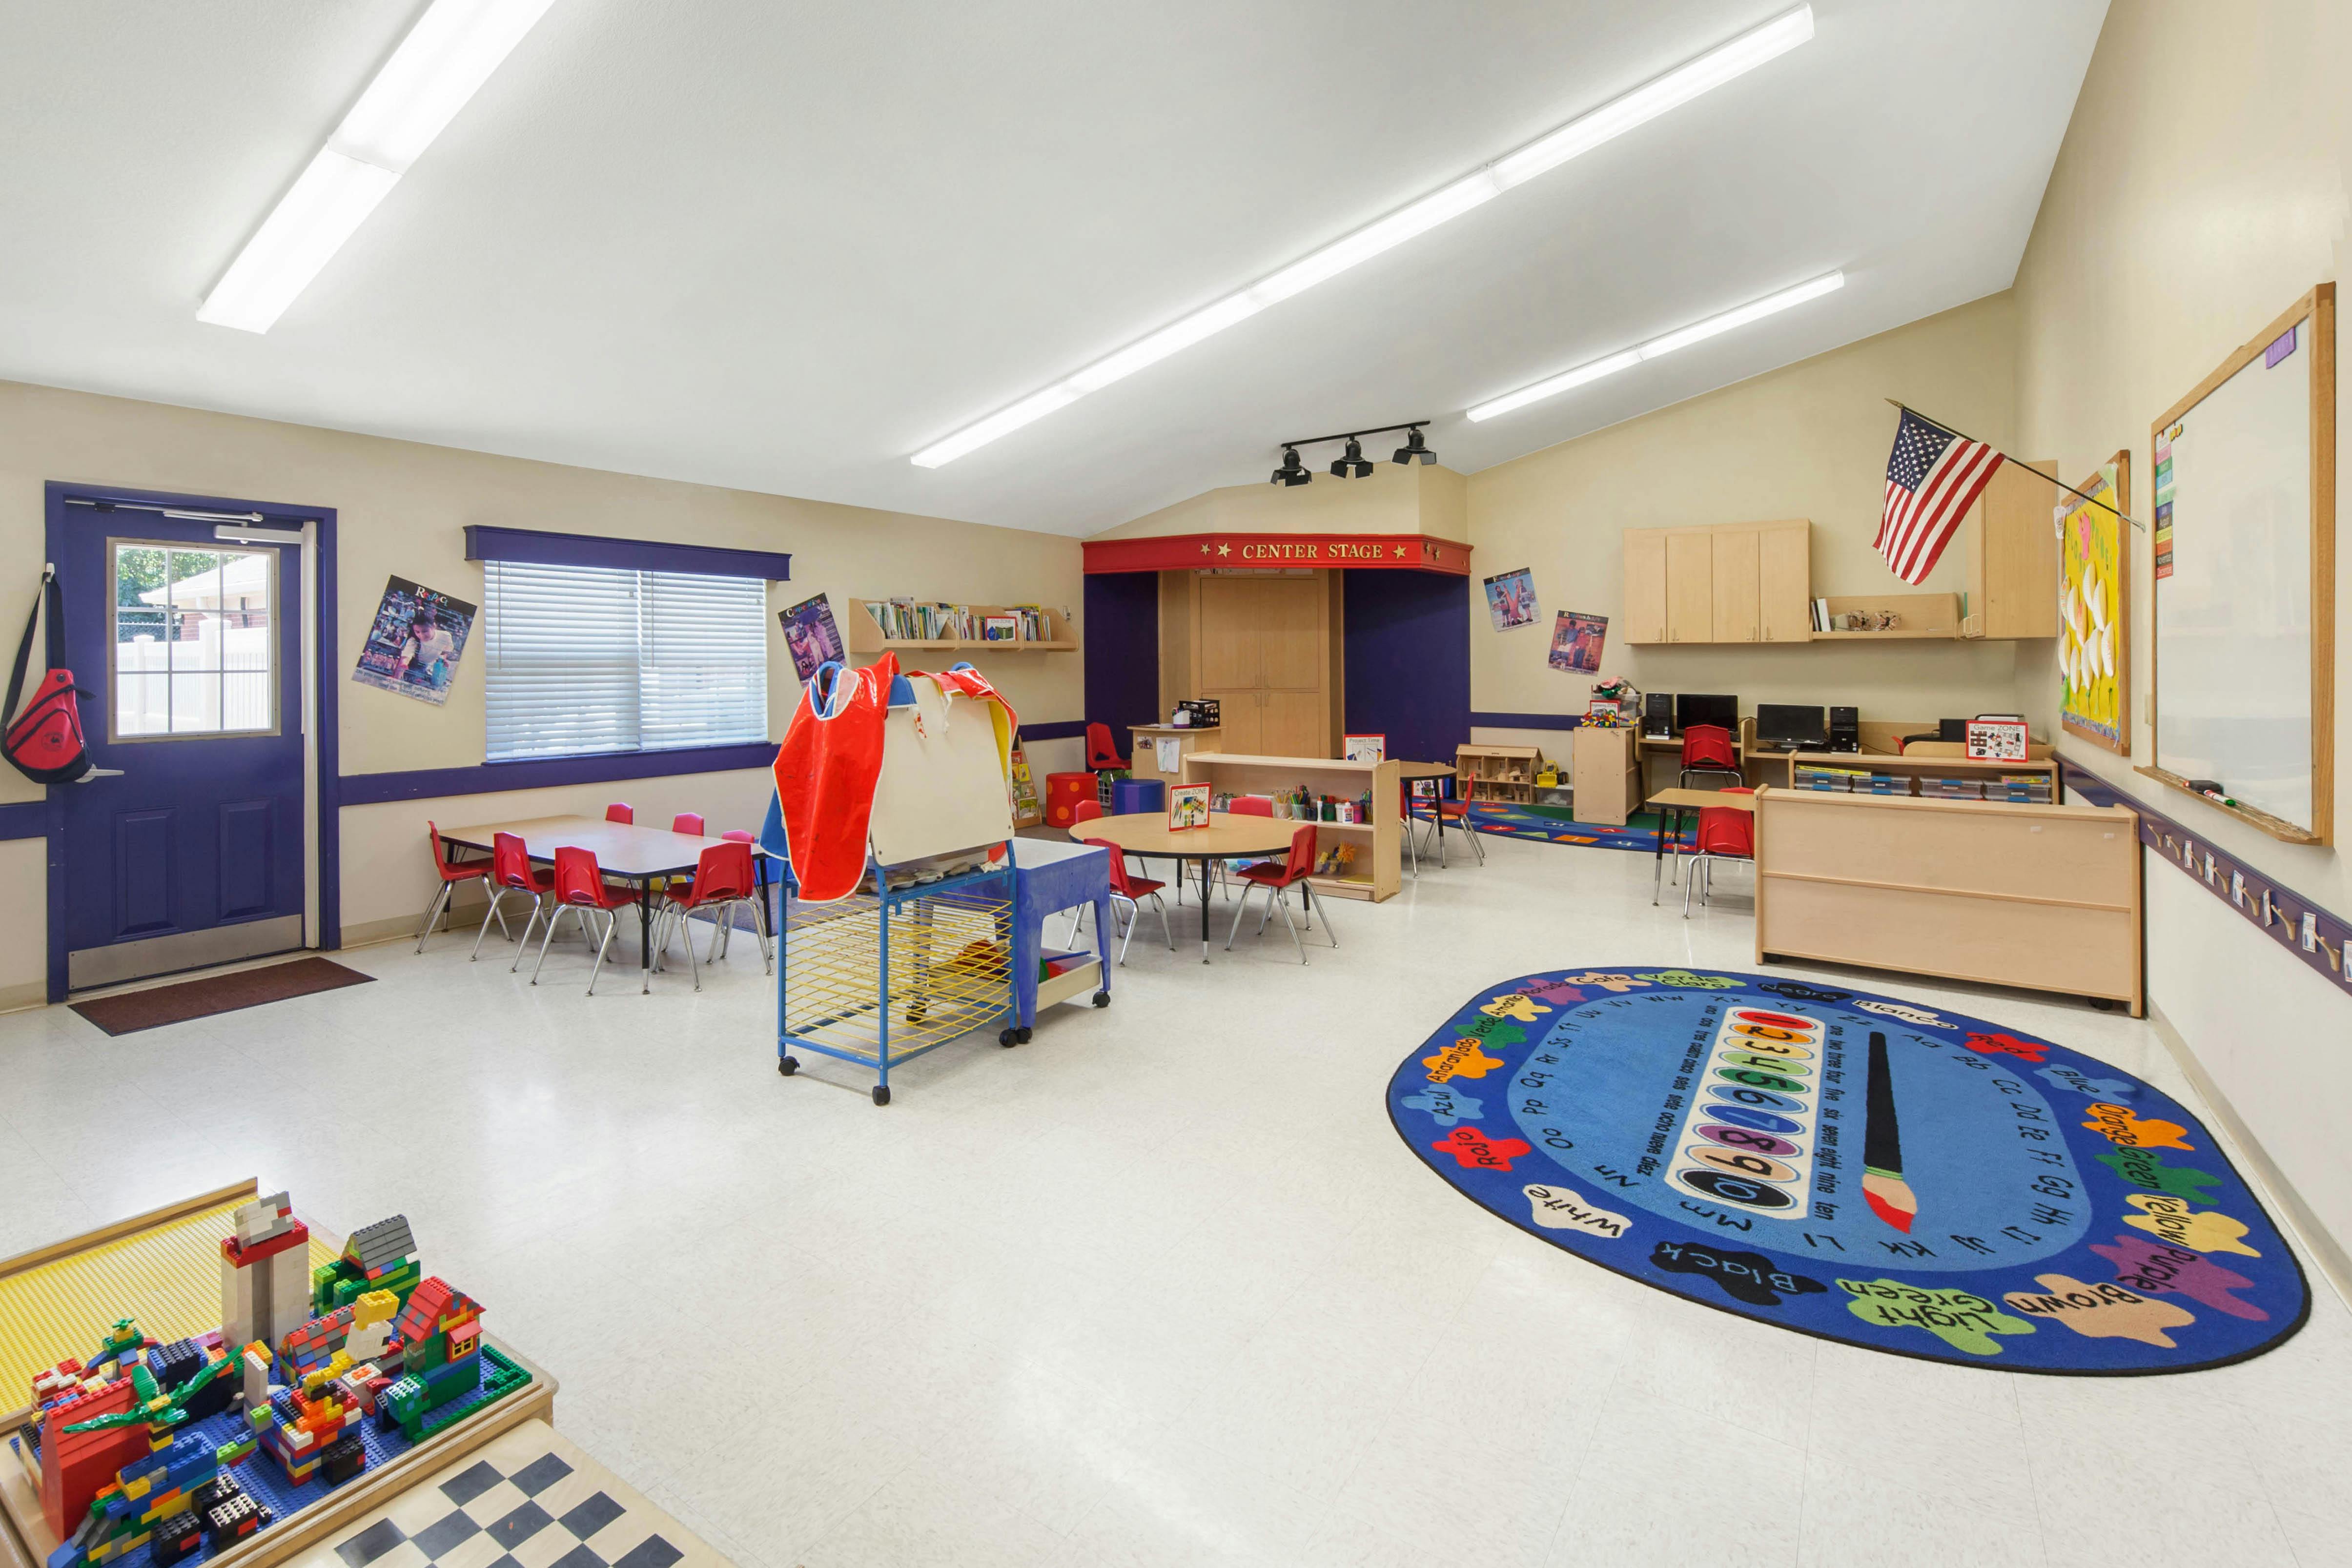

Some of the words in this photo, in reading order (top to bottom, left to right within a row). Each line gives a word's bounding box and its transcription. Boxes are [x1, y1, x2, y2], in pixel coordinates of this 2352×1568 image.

[1243, 545, 1317, 559] CENTER
[1328, 544, 1383, 558] STAGE
[415, 586, 448, 607] Respect
[1576, 975, 1628, 984] Cafe
[1644, 974, 1720, 983] Verde
[1662, 979, 1725, 988] Claro
[1517, 982, 1570, 996] Morado
[1761, 983, 1837, 999] Negro
[1490, 994, 1524, 1016] Amarillo
[1855, 1000, 1955, 1029] Blanco
[1467, 1017, 1503, 1038] Verde
[1698, 1018, 1718, 1027] dos
[1754, 1016, 1798, 1024] 1
[1694, 1030, 1712, 1041] tres
[1747, 1026, 1793, 1040] 2
[1829, 1025, 1843, 1036] one
[1686, 1042, 1705, 1058] cuatro
[1745, 1041, 1790, 1054] 3
[1828, 1039, 1847, 1050] two
[1971, 1035, 2032, 1054] Red
[1428, 1038, 1476, 1081] Anaranjado
[1678, 1059, 1700, 1074] cinco
[1742, 1057, 1787, 1072] 4
[1827, 1052, 1846, 1068] three
[1672, 1076, 1691, 1090] seis
[1735, 1071, 1788, 1088] 5
[1825, 1069, 1846, 1084] four
[2051, 1070, 2100, 1093] Blue
[1663, 1094, 1686, 1110] siete
[1733, 1089, 1783, 1106] 6
[1824, 1087, 1845, 1101] five
[1427, 1091, 1454, 1117] Azul
[1655, 1112, 1677, 1132] ocho
[1726, 1111, 1778, 1130] 7
[1823, 1108, 1845, 1120] six
[2095, 1104, 2139, 1145] Orange
[1646, 1132, 1668, 1155] nueve
[1718, 1130, 1776, 1151] 8
[1820, 1124, 1839, 1146] seven
[1455, 1132, 1504, 1165] Rojo
[1814, 1147, 1842, 1169] eight
[1636, 1156, 1662, 1177] diez
[1705, 1155, 1773, 1176] 9
[2118, 1146, 2161, 1189] Green
[1714, 1177, 1761, 1200] 10
[1817, 1172, 1841, 1194] nine
[1529, 1186, 1621, 1236] White
[1814, 1201, 1841, 1220] ten
[2143, 1195, 2192, 1246] Yellow
[1661, 1243, 1799, 1292] Black
[2117, 1245, 2199, 1290] Purple
[1842, 1281, 1993, 1313] Green
[2006, 1284, 2144, 1313] Brown
[1876, 1304, 2000, 1331] Light
